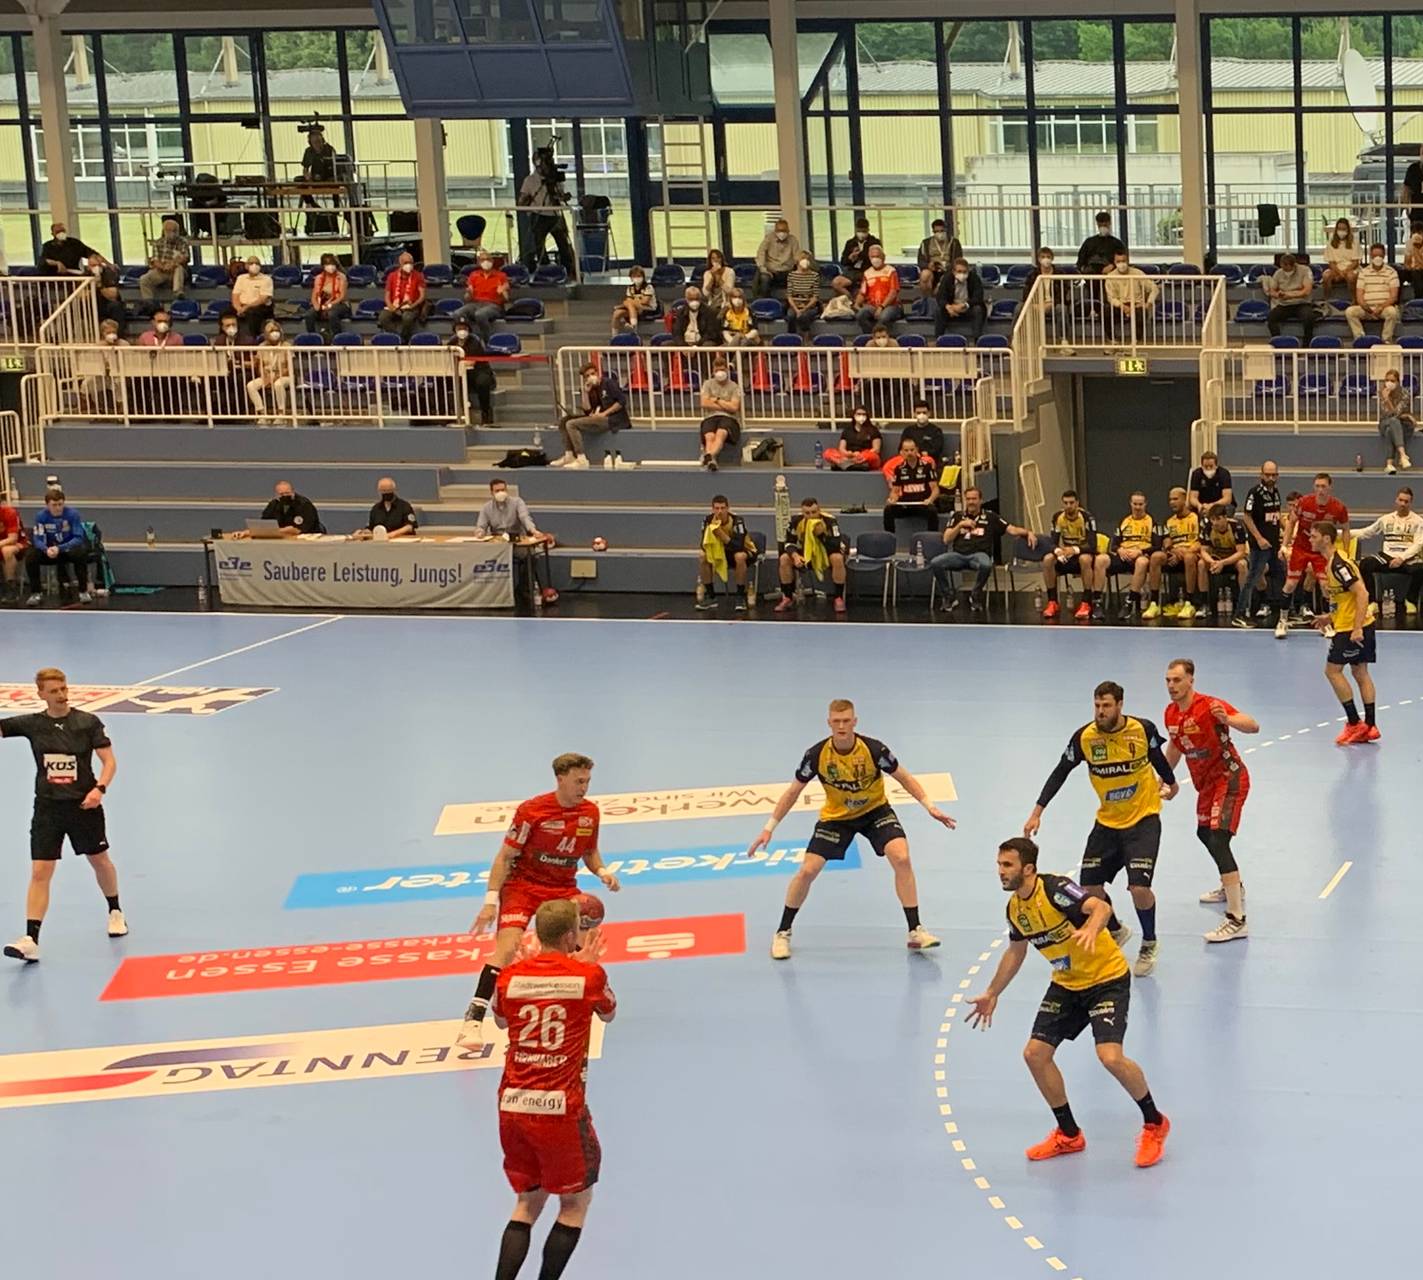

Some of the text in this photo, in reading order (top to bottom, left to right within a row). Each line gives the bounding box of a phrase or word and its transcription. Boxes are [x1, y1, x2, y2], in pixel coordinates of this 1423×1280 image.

[263, 560, 463, 588] Saubere Leistung, Jungs!
[556, 836, 577, 853] 44
[166, 959, 319, 982] Essen
[517, 1004, 567, 1051] 26
[161, 1042, 510, 1086] RENNTAG
[522, 1094, 564, 1111] energy
